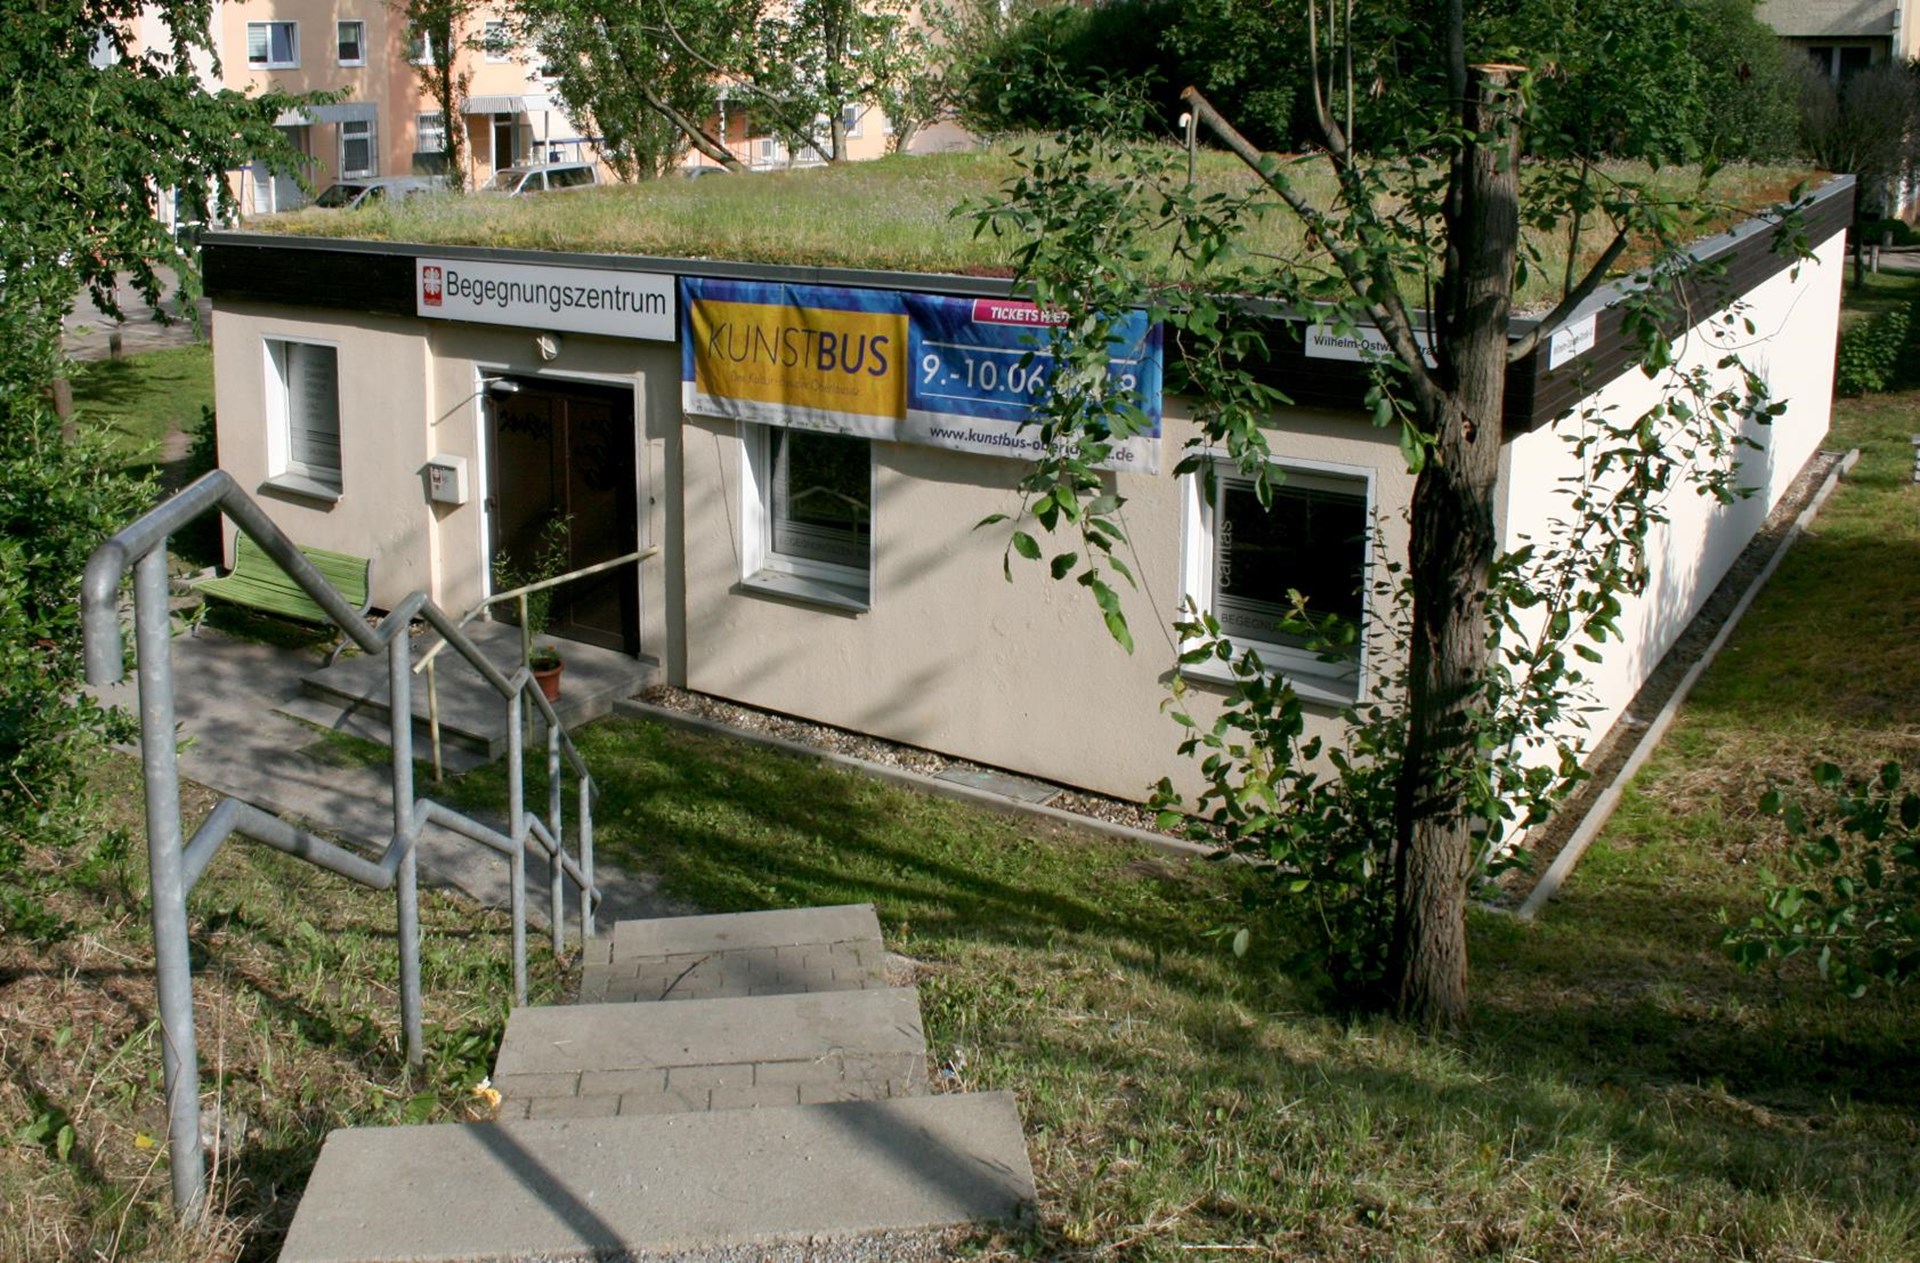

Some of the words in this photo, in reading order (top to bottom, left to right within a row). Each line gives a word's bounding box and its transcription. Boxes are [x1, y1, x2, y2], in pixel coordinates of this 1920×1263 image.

[446, 270, 667, 315] Begegnungszentrum
[990, 306, 1039, 322] TICKETS
[707, 320, 890, 377] KUNSTBUS
